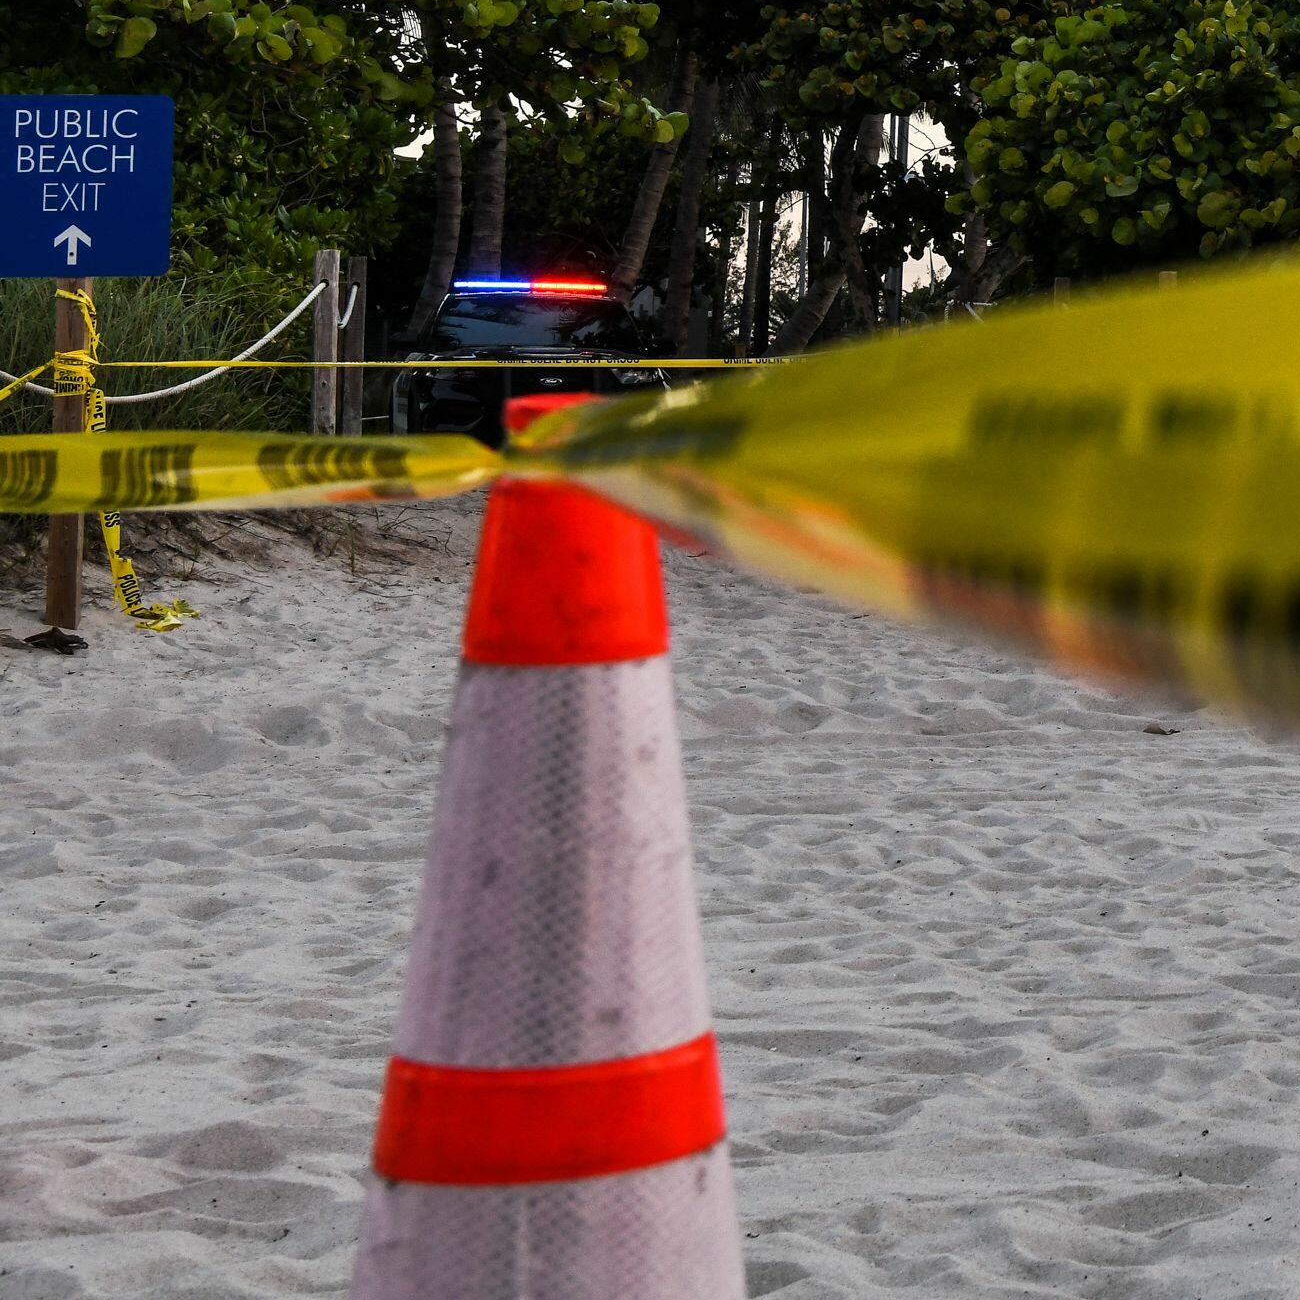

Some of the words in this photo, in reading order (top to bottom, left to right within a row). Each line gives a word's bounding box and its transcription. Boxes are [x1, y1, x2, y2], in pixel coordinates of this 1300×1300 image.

[15, 109, 138, 138] PUBLIC
[17, 144, 135, 173] BEACH
[42, 182, 106, 212] EXIT
[117, 574, 141, 608] POLICE
